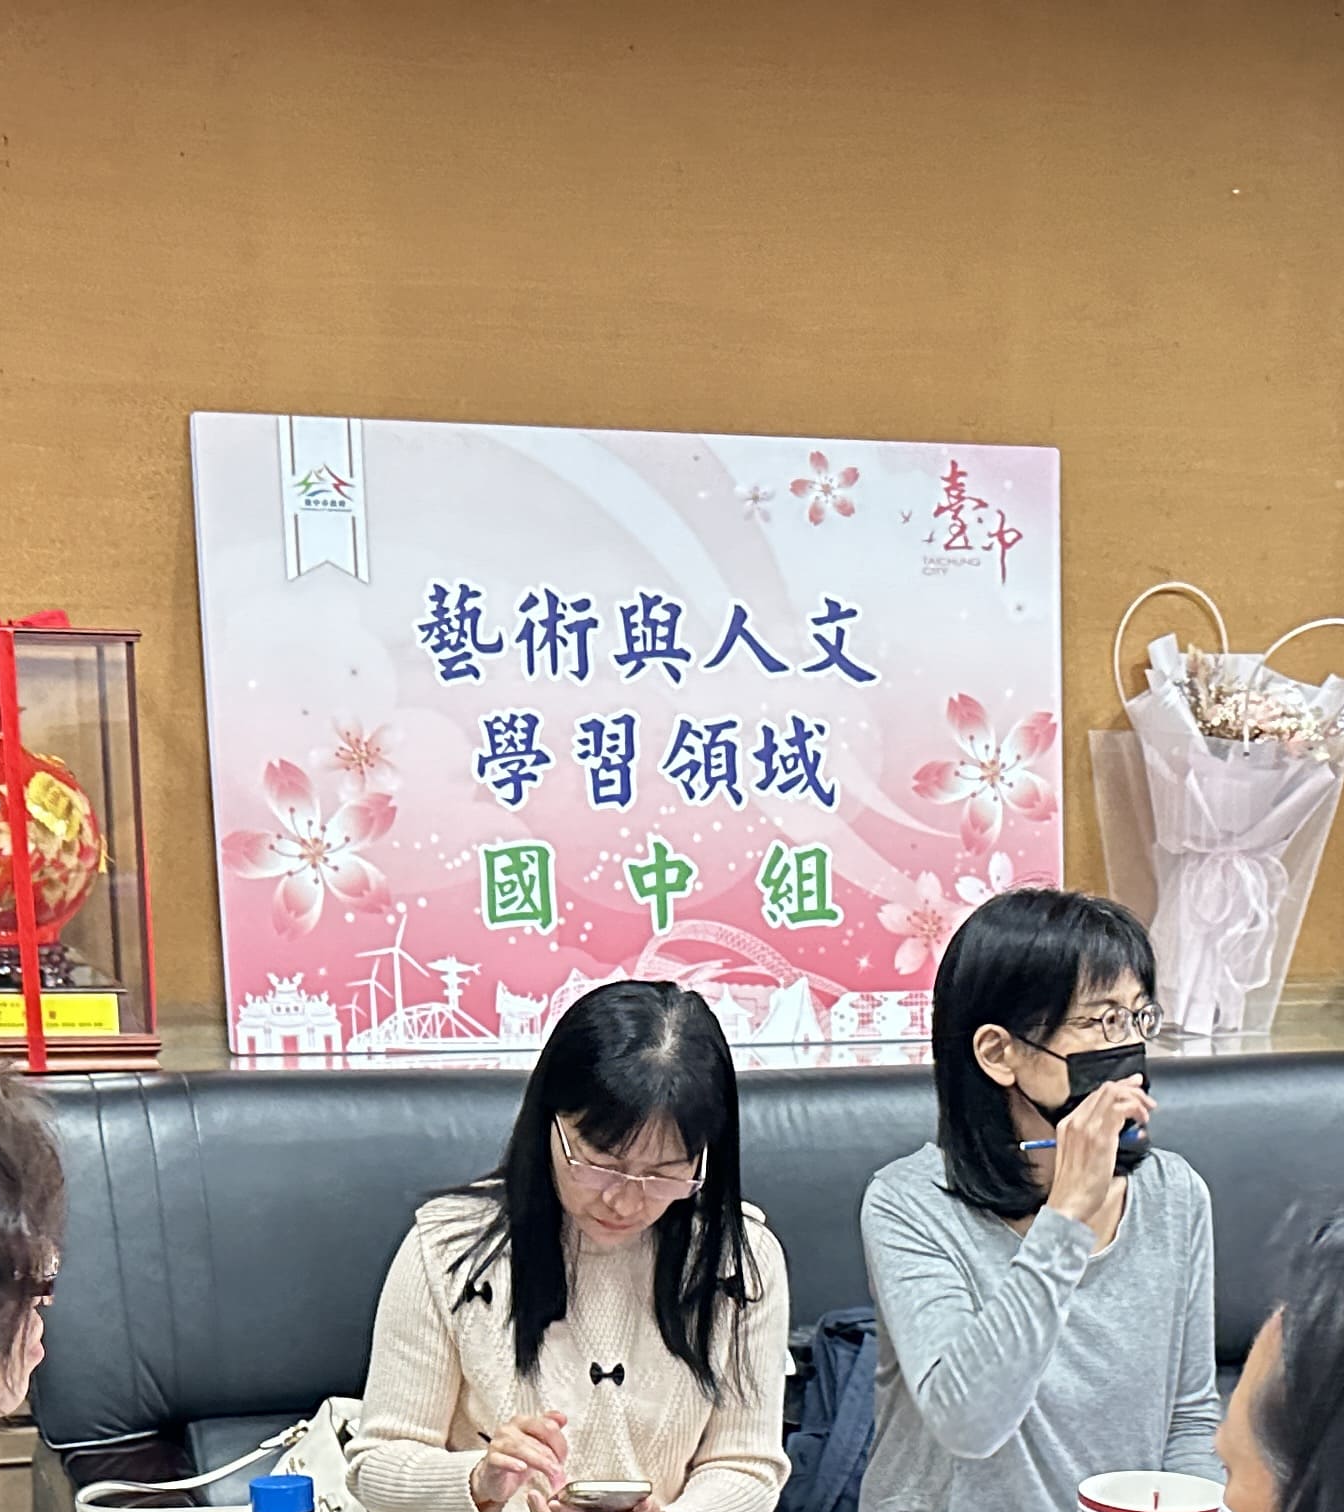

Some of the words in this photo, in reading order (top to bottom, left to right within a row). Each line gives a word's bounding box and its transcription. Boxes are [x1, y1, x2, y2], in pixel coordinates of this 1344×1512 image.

[418, 583, 877, 684] 藝術與人文
[476, 713, 837, 808] 學習領域
[484, 844, 838, 930] 國中組
